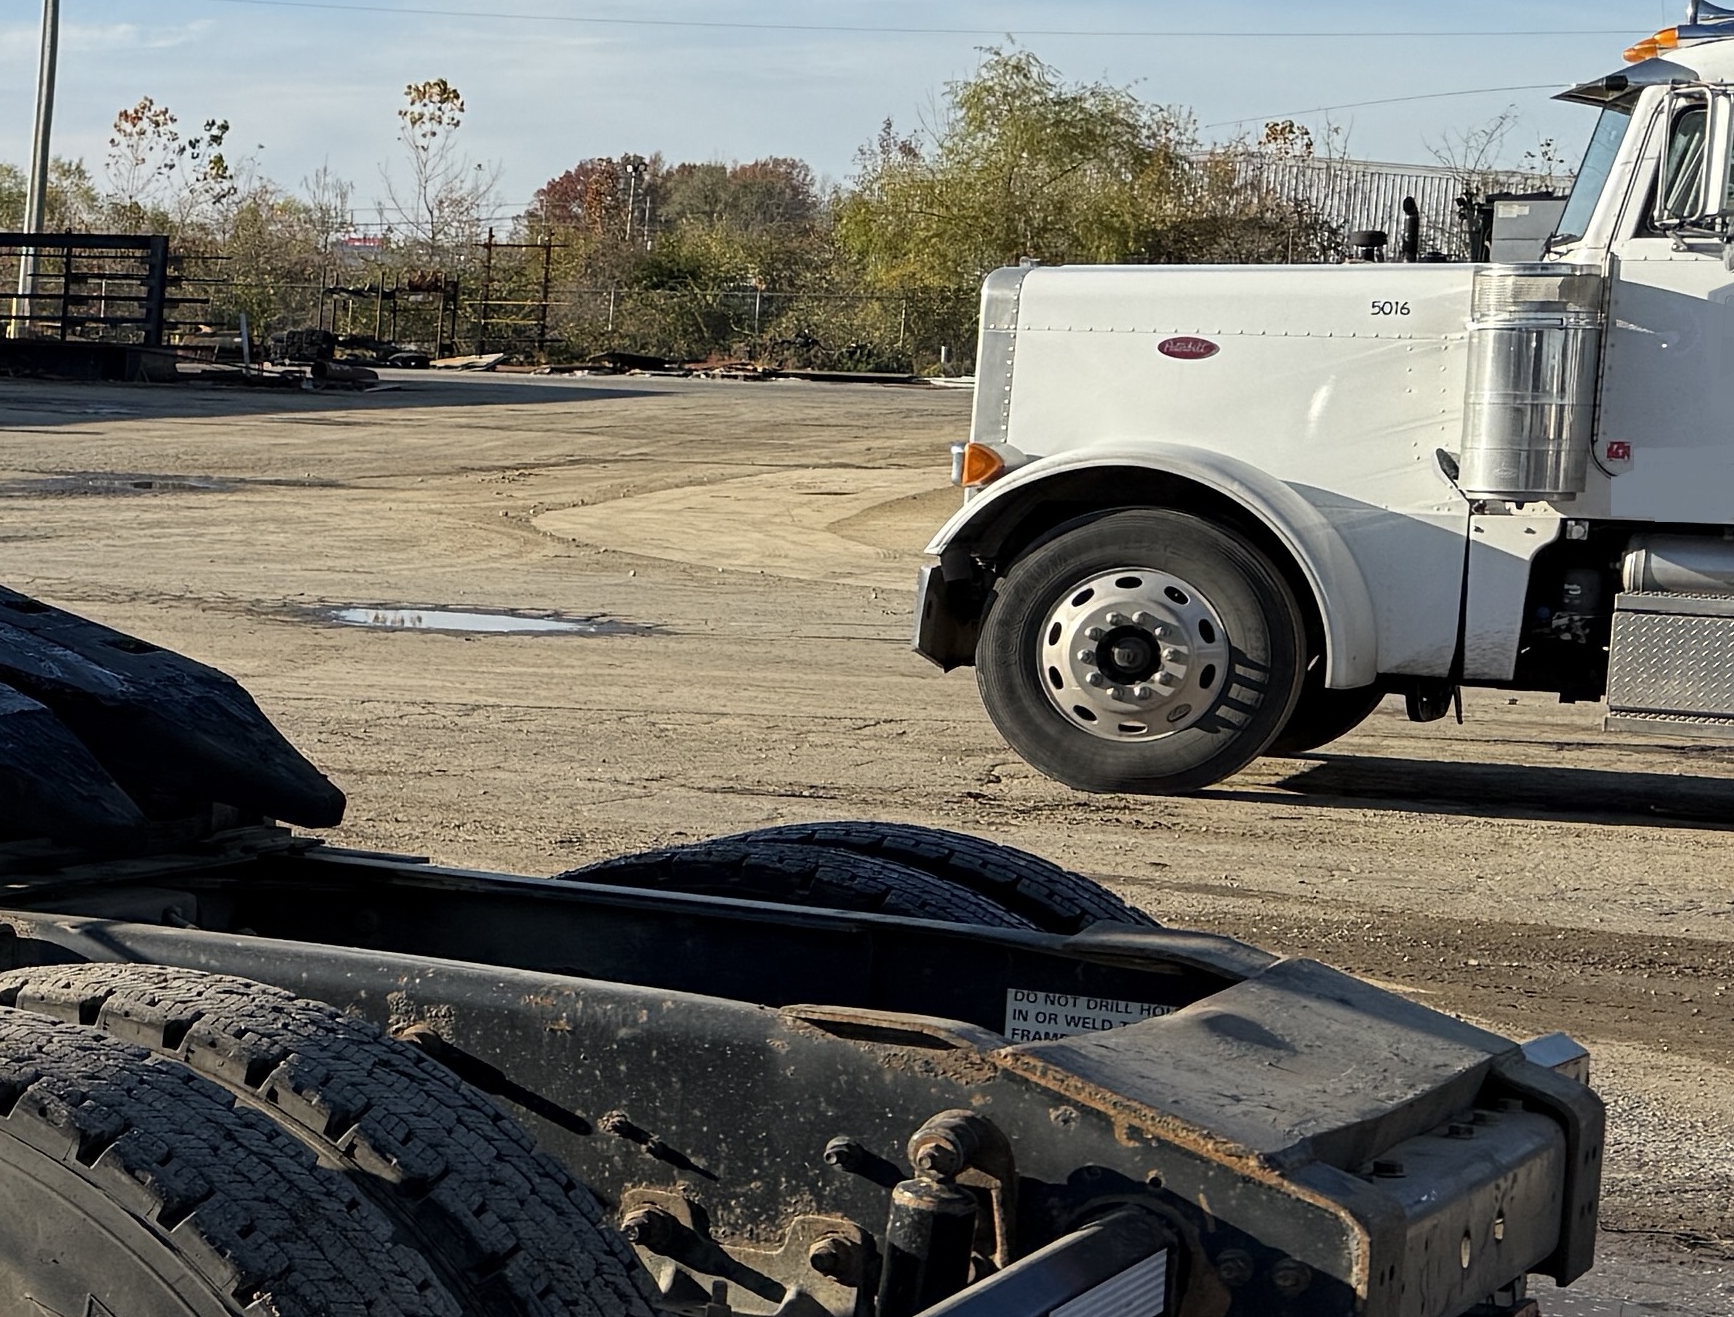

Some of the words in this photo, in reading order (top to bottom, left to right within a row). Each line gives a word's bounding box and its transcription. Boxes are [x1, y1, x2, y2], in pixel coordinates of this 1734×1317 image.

[1370, 300, 1412, 316] 5016
[1013, 990, 1038, 1004] DO
[1044, 994, 1080, 1008] NOT
[1086, 998, 1133, 1014] DRILL
[1012, 1008, 1029, 1022] IN
[1034, 1011, 1059, 1025] OR
[1064, 1014, 1113, 1031] WELD
